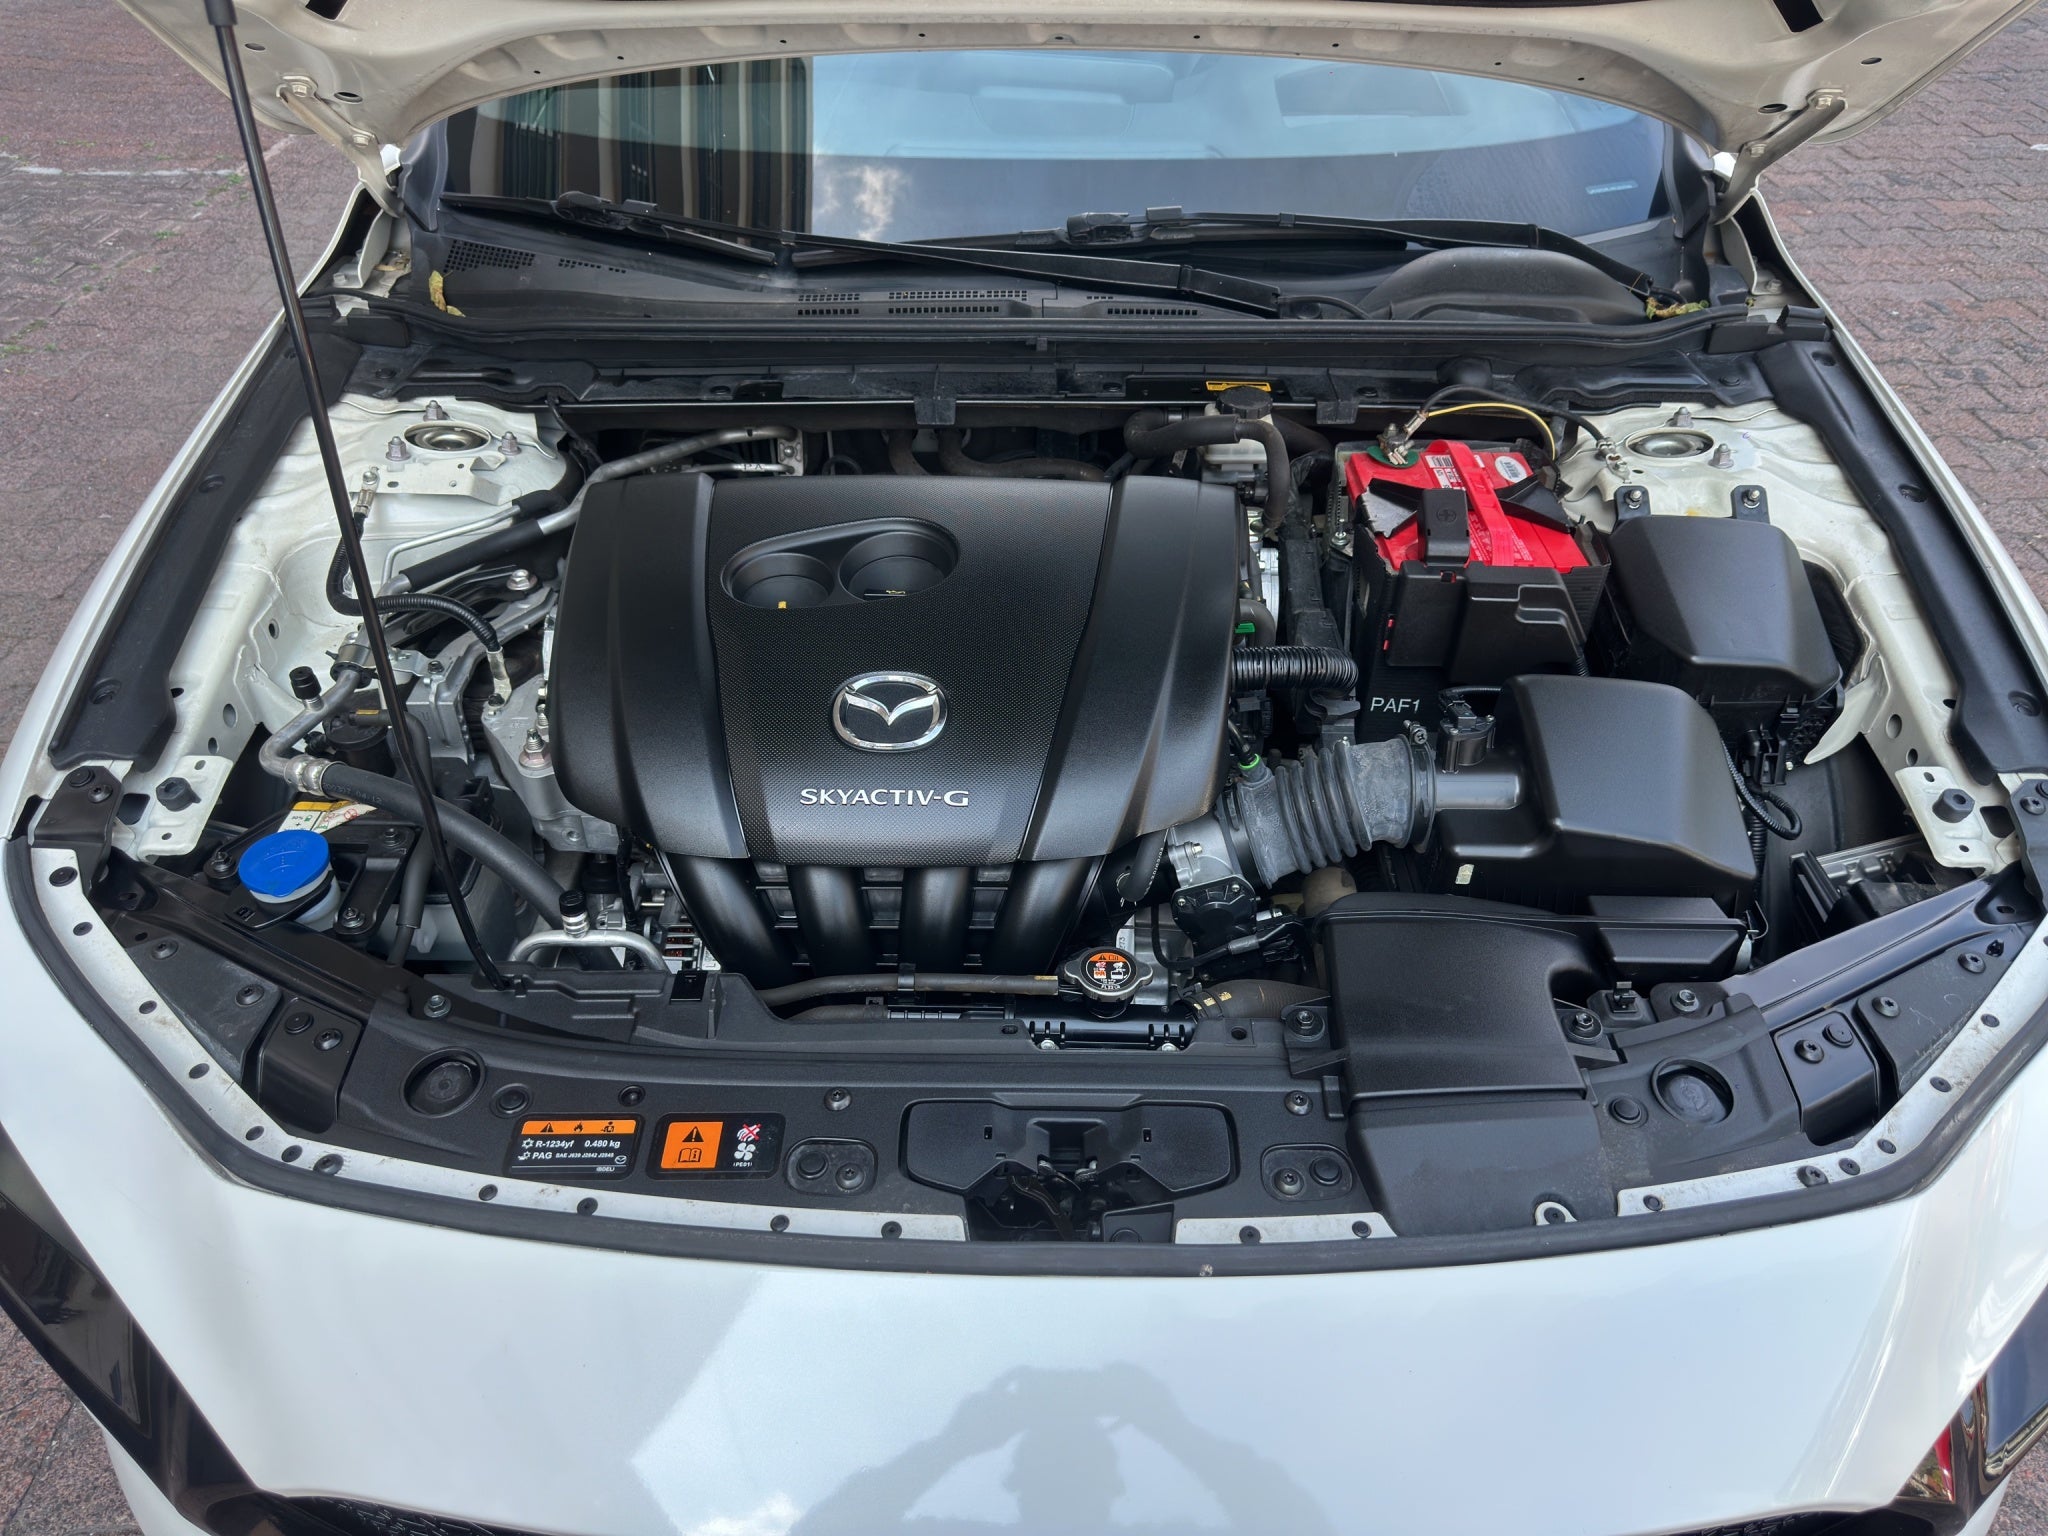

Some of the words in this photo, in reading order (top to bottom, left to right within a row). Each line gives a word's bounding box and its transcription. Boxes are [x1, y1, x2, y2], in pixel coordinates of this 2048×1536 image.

[1370, 697, 1420, 713] PAF1
[799, 788, 970, 807] SKYACTIV-G
[535, 1139, 575, 1149] R-1234yf
[584, 1139, 608, 1148] 0.480
[609, 1139, 621, 1149] kg
[532, 1151, 553, 1160] PAG
